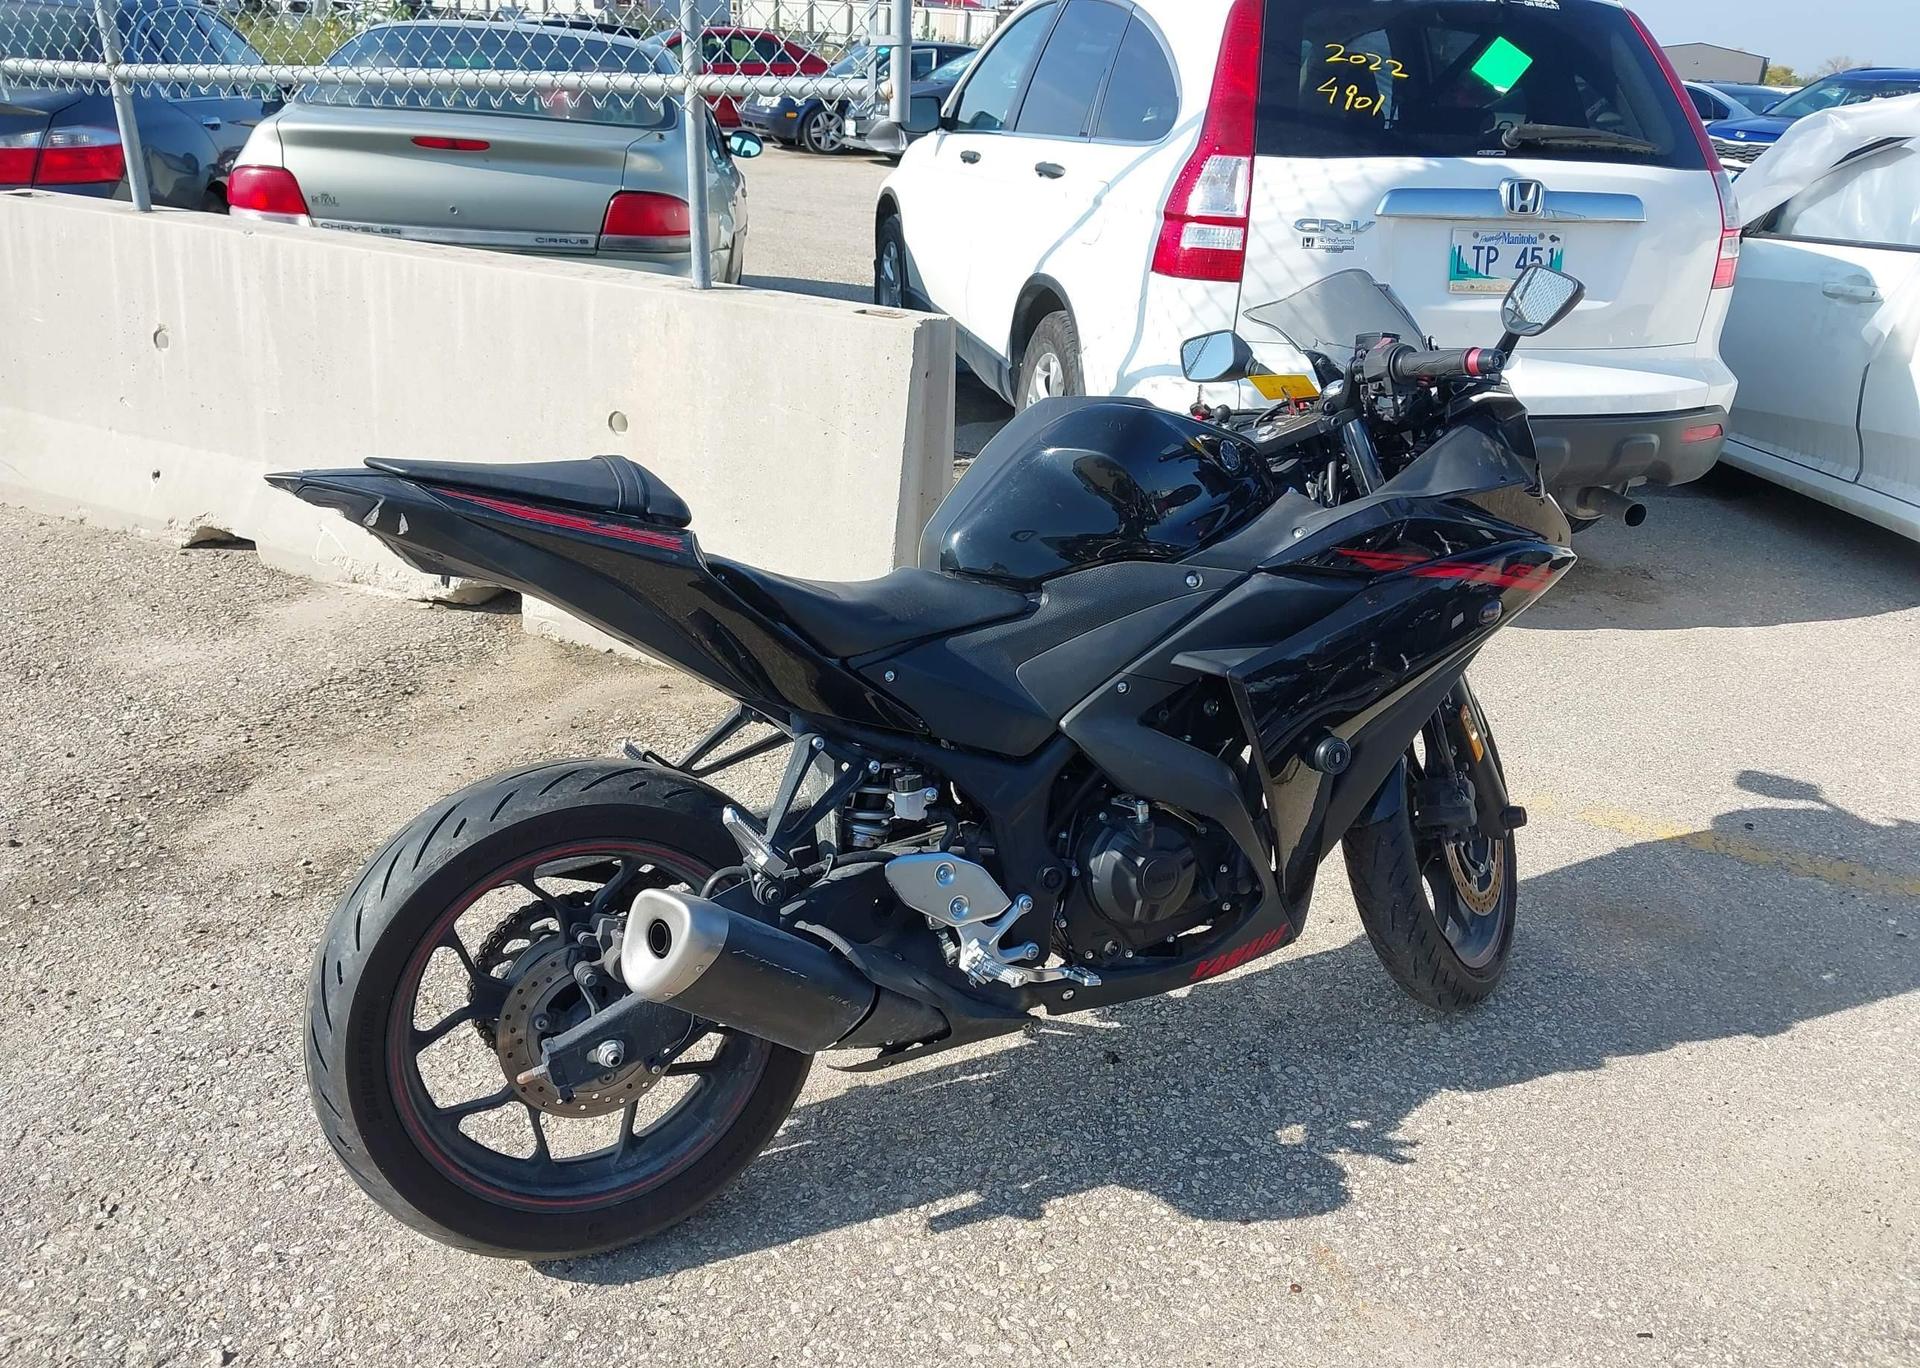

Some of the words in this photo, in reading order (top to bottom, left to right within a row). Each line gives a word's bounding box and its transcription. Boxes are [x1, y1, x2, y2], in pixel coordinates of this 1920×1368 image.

[1324, 43, 1410, 78] 2022
[1316, 77, 1386, 116] 4901
[320, 221, 401, 235] CHRYSLER
[1293, 218, 1376, 233] CR-V
[535, 237, 590, 245] CIRRUS
[1503, 231, 1538, 245] Manitoba
[1456, 244, 1500, 275] LTP
[1514, 246, 1556, 273] 451
